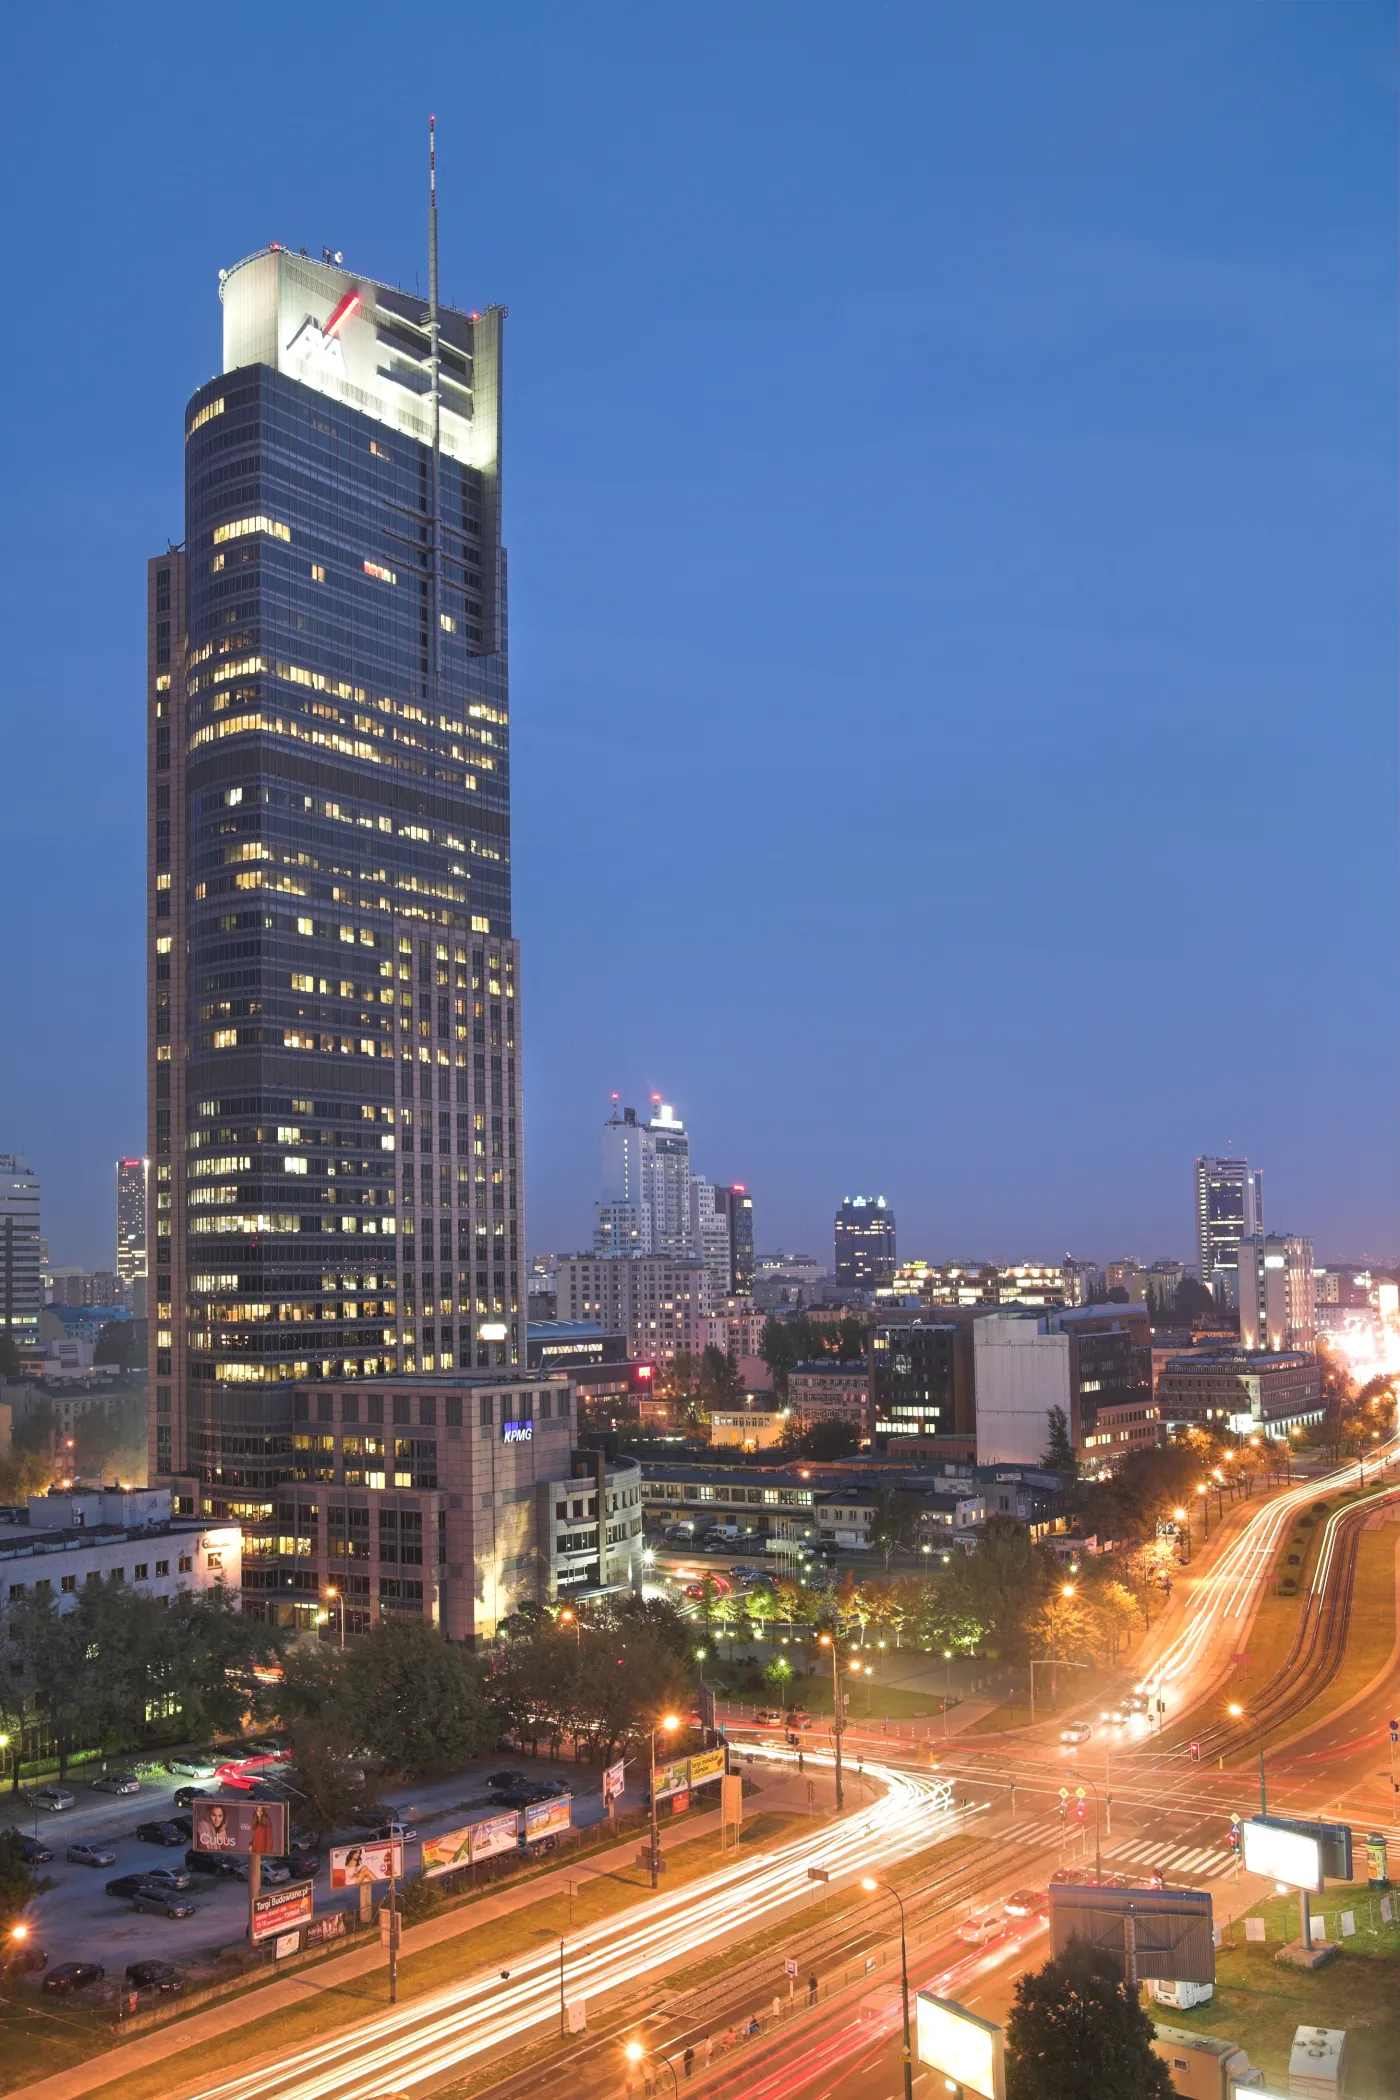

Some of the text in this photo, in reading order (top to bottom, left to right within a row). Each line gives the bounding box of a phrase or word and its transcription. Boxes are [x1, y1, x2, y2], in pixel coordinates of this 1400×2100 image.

[503, 1427, 533, 1443] KPMG
[200, 1832, 236, 1847] Cubus
[256, 1900, 271, 1912] Targi
